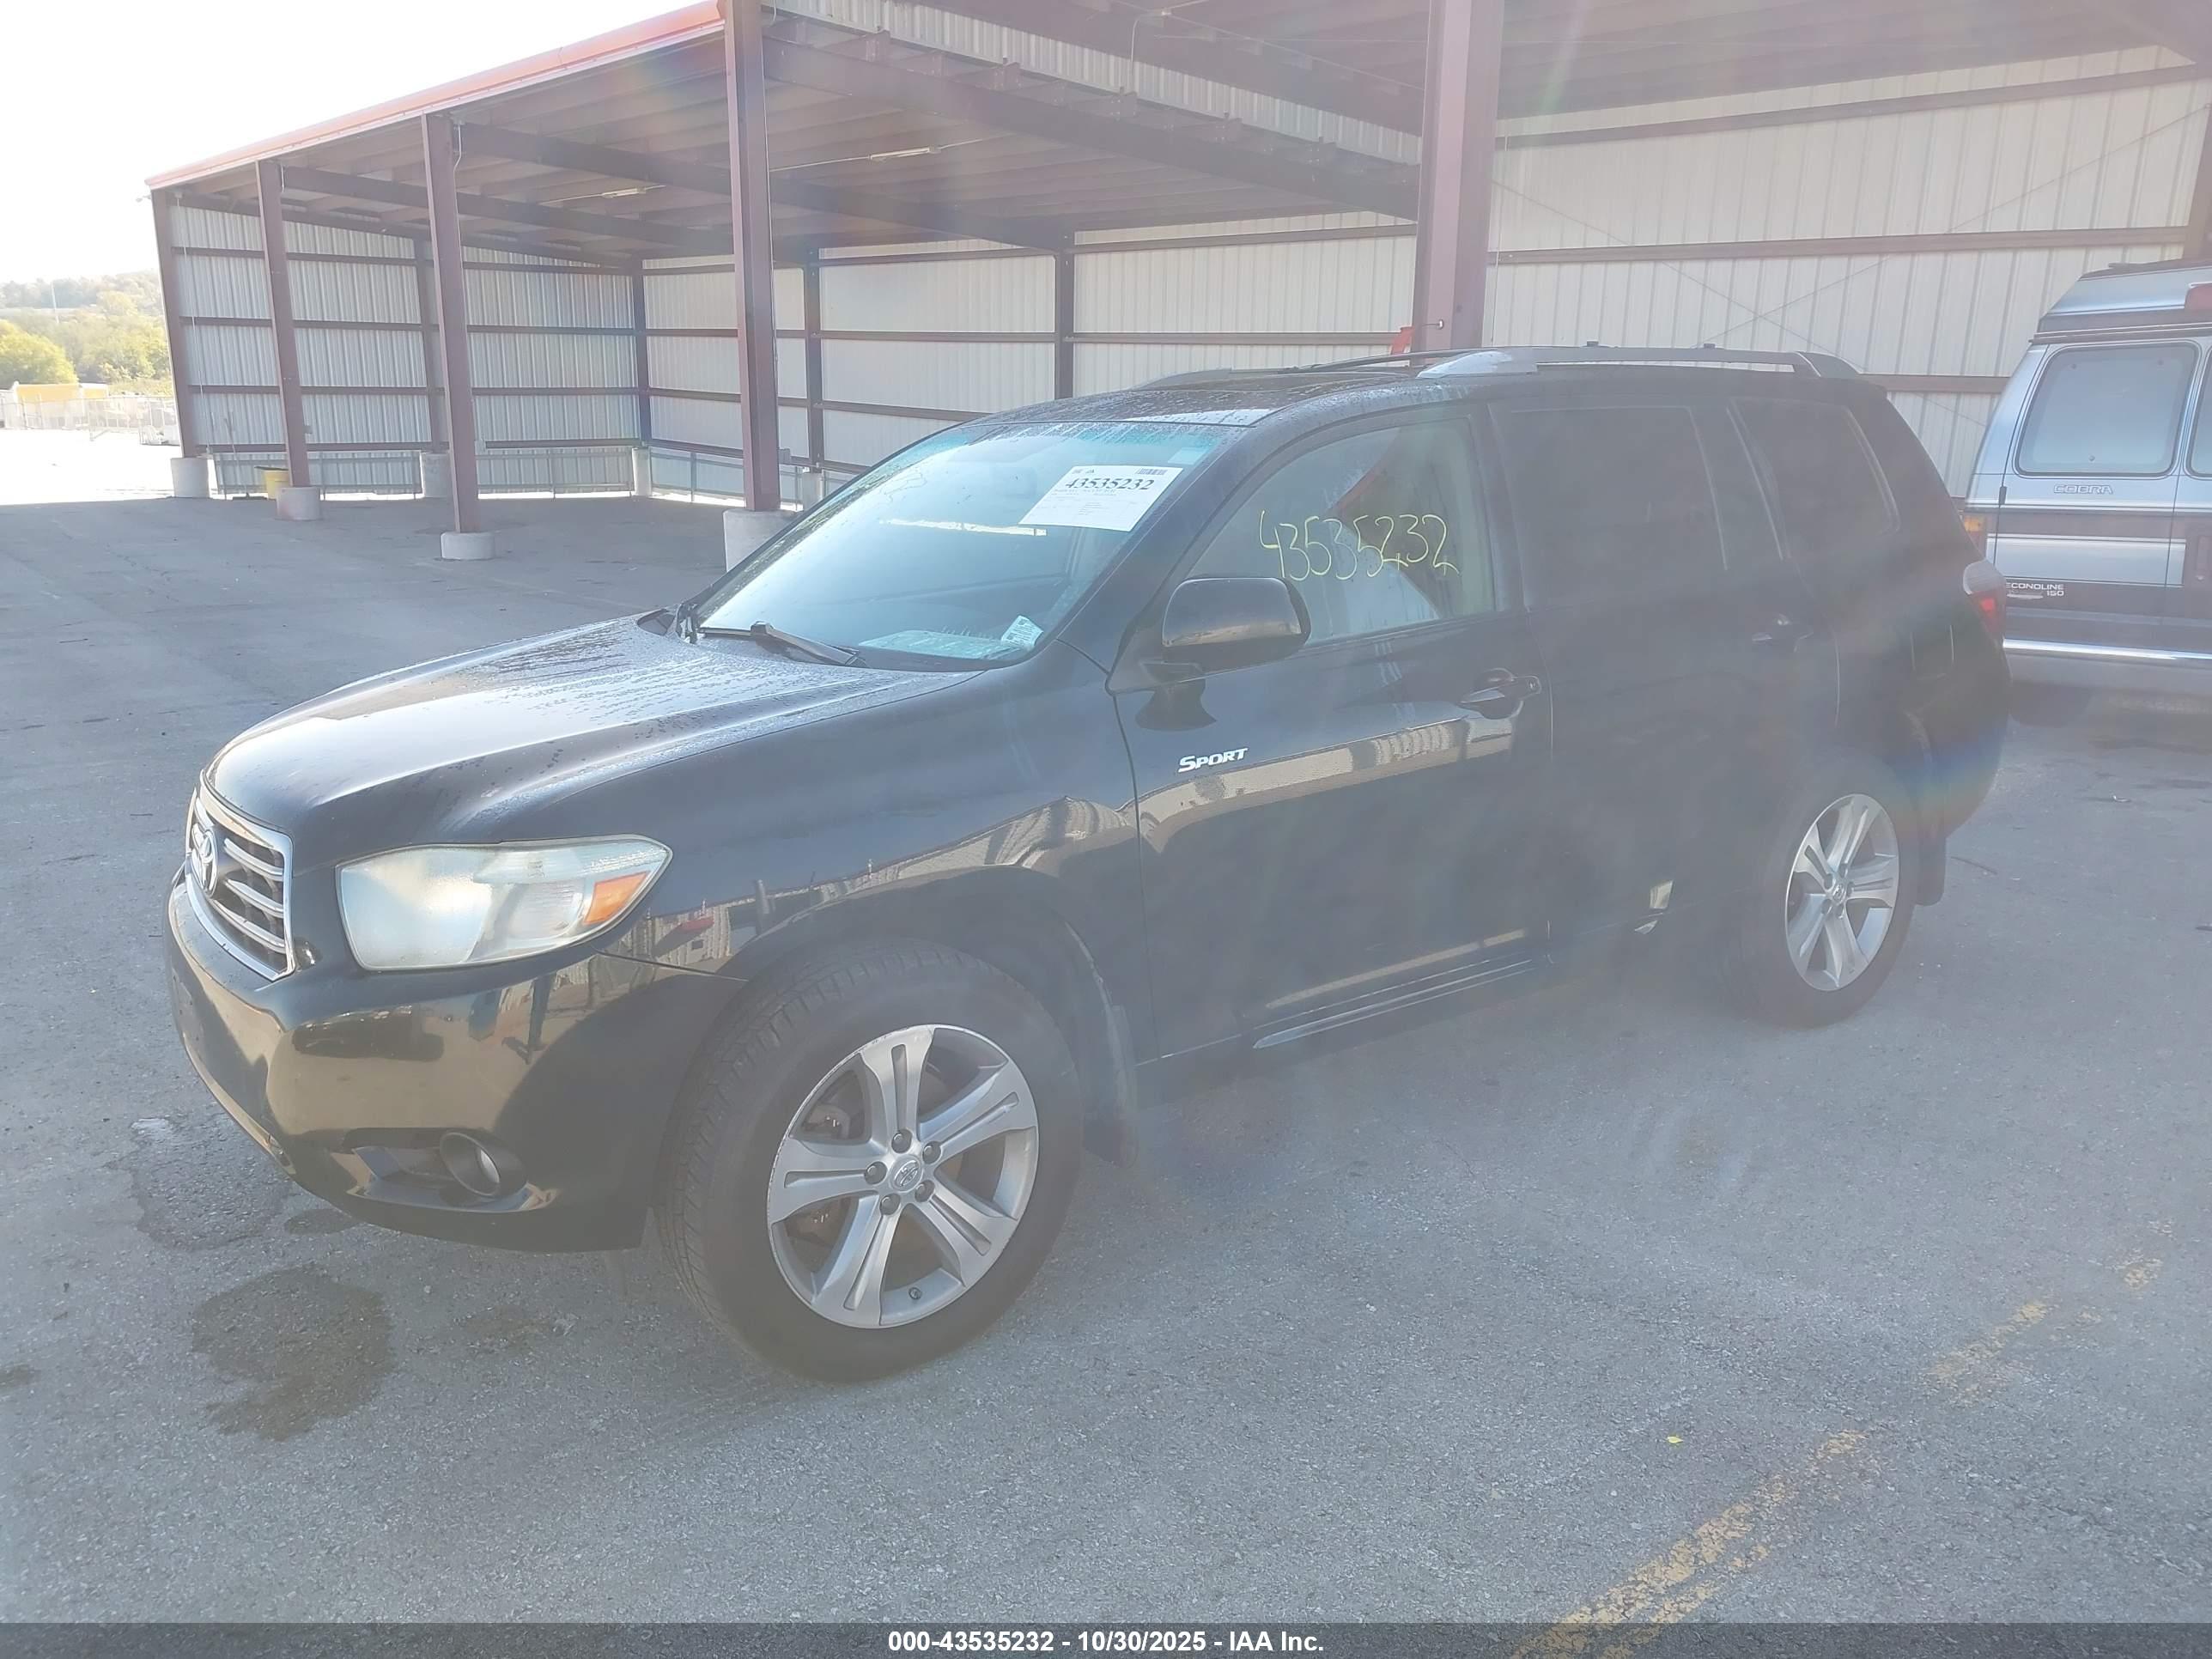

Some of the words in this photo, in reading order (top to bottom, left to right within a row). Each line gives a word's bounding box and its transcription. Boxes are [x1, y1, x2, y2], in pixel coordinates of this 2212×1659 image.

[1066, 477, 1155, 490] 43535232
[2053, 483, 2114, 495] COBRA
[1258, 509, 1461, 581] 43535232
[2005, 582, 2065, 591] ECONOLINE
